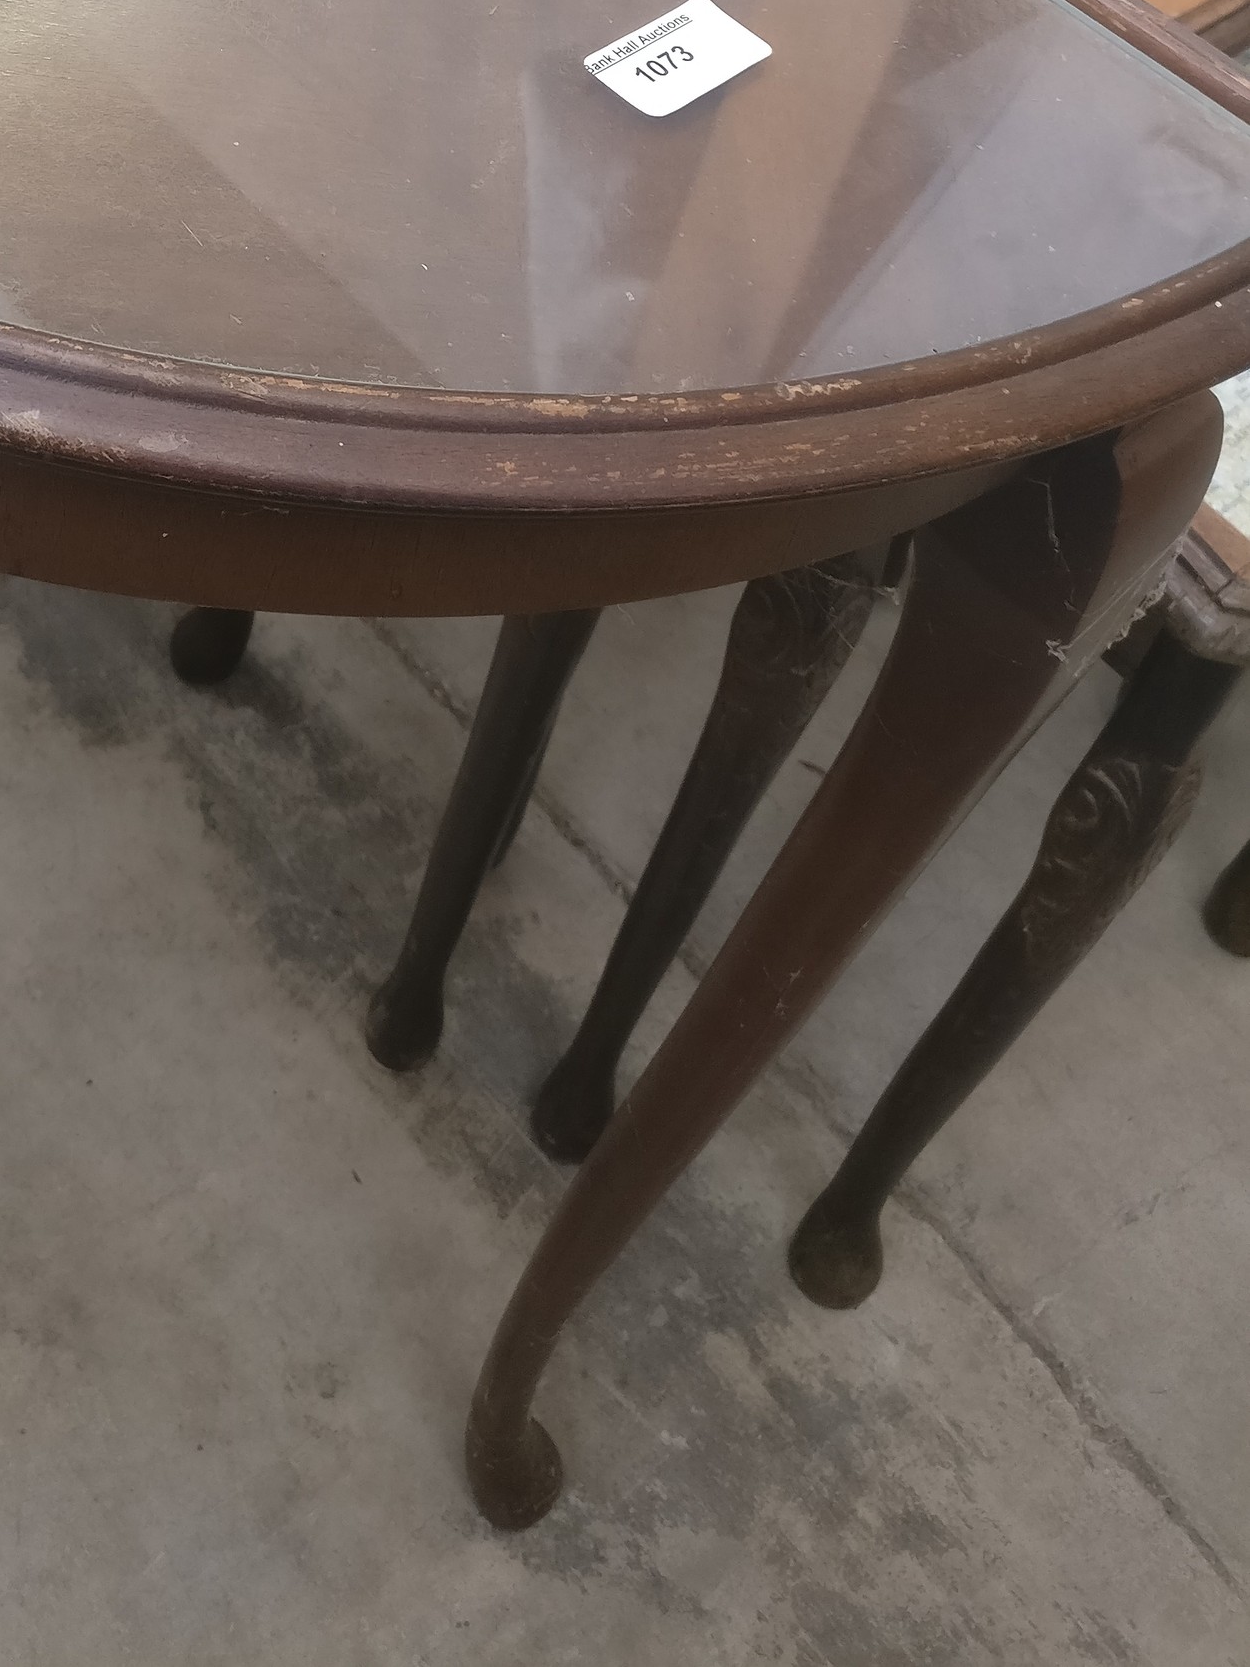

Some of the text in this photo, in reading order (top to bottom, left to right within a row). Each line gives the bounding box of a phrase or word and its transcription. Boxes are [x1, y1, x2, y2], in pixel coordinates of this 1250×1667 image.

[612, 40, 639, 58] Hall
[638, 14, 690, 45] Auctions
[636, 45, 694, 82] 1073
